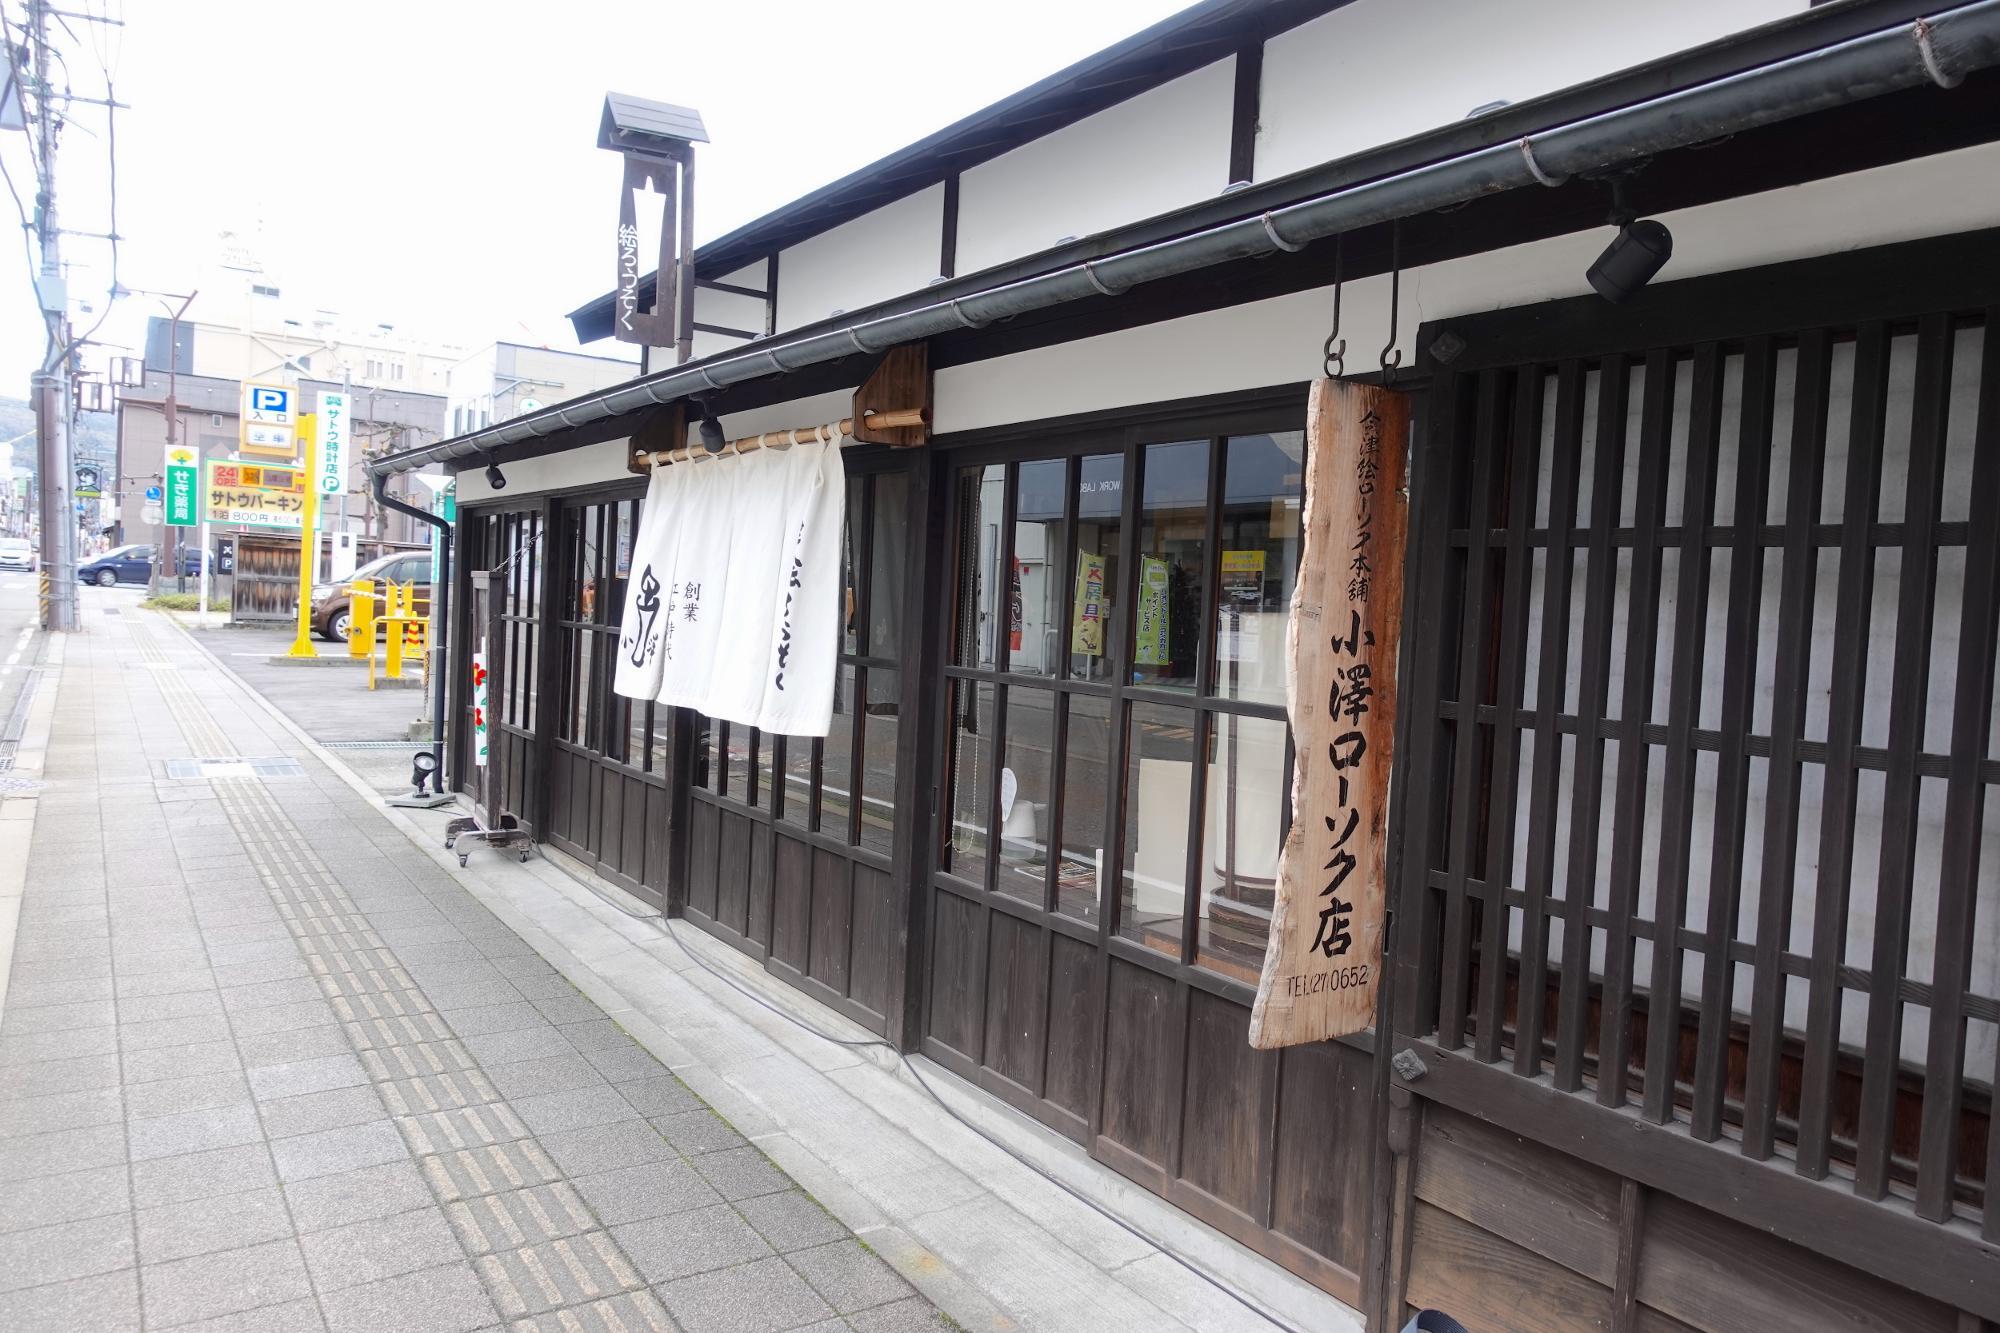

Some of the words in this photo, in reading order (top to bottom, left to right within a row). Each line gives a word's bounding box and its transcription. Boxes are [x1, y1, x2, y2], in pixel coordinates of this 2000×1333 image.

[619, 223, 638, 331] 絵ろうそく
[253, 411, 287, 422] 入口
[257, 390, 284, 411] P
[325, 409, 339, 474] サトウ時計店
[174, 470, 189, 520] せき薬局
[232, 511, 268, 522] 800円
[1348, 410, 1381, 602] 会津絵ローソク本舗
[683, 581, 702, 622] 創業
[1309, 609, 1375, 958] 小澤ローソク店
